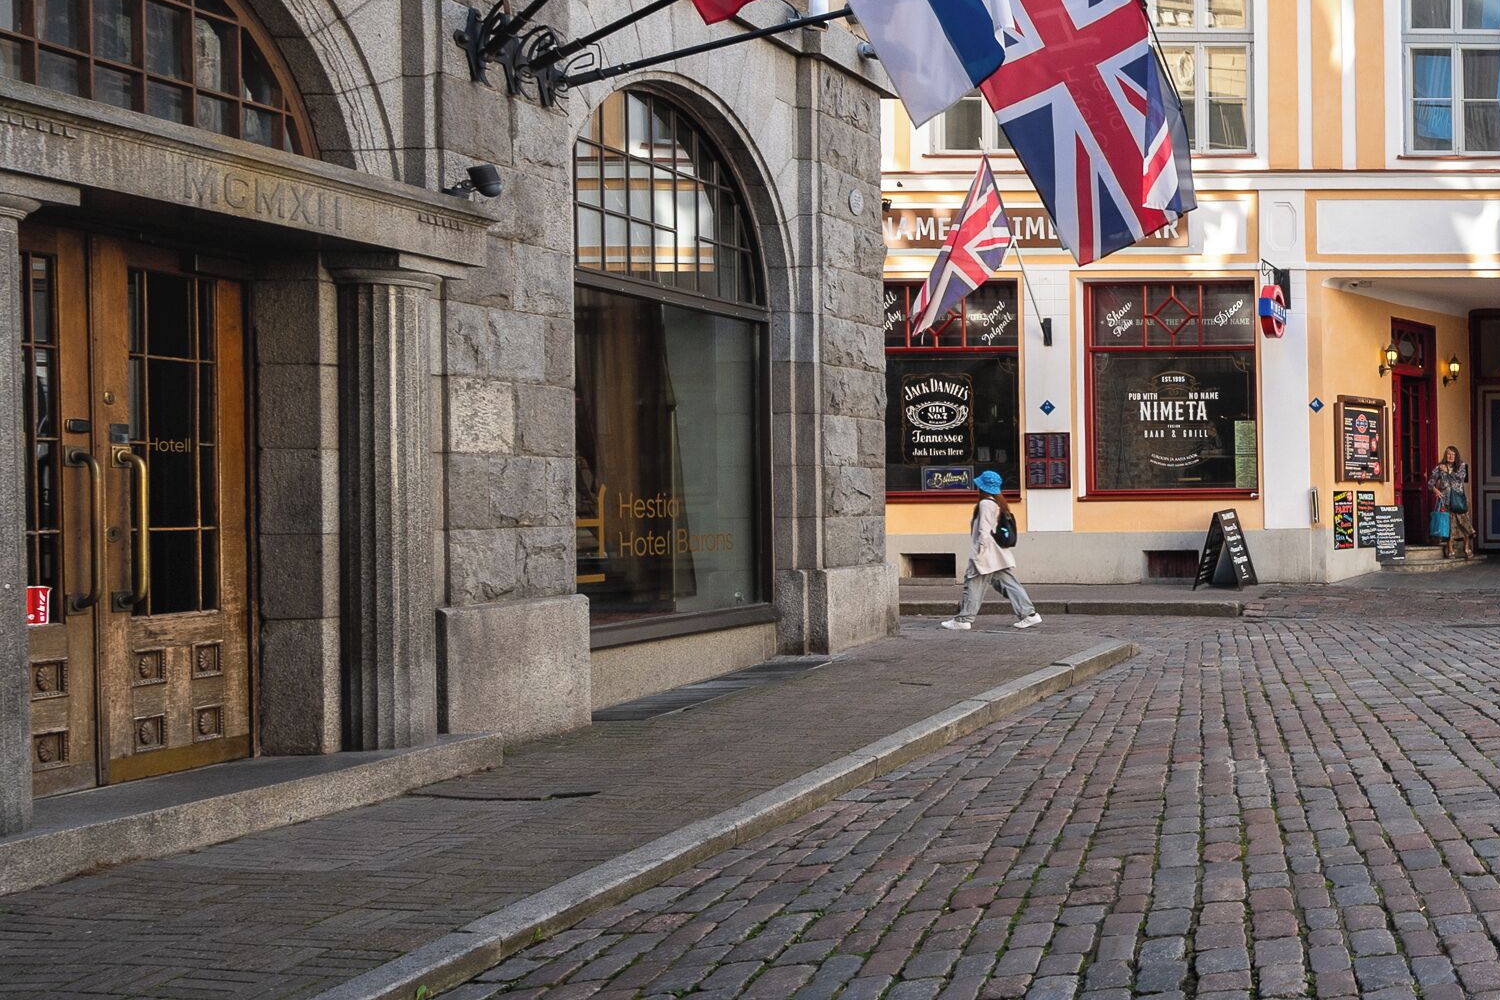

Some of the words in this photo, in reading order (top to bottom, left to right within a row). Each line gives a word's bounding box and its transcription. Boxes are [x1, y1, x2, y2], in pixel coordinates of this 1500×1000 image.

[183, 162, 343, 231] MCMXII
[980, 300, 1006, 327] Sport
[1106, 301, 1132, 328] Show
[1213, 299, 1244, 327] Disco
[904, 382, 930, 401] JACK
[1128, 392, 1141, 400] PUB
[1142, 392, 1158, 400] WITH
[1188, 392, 1199, 400] NO
[1200, 391, 1219, 400] NAME
[928, 405, 946, 413] Old
[1139, 401, 1208, 421] NIMETA
[912, 430, 964, 443] Tennessee
[1144, 430, 1165, 438] BAAR
[1171, 430, 1177, 438] &
[1183, 429, 1208, 438] GRILL
[912, 448, 928, 456] Jack
[929, 448, 947, 456] Lives
[947, 448, 964, 456] Here
[618, 492, 680, 519] Hestia
[618, 529, 672, 558] Hotel
[676, 528, 734, 554] Barons
